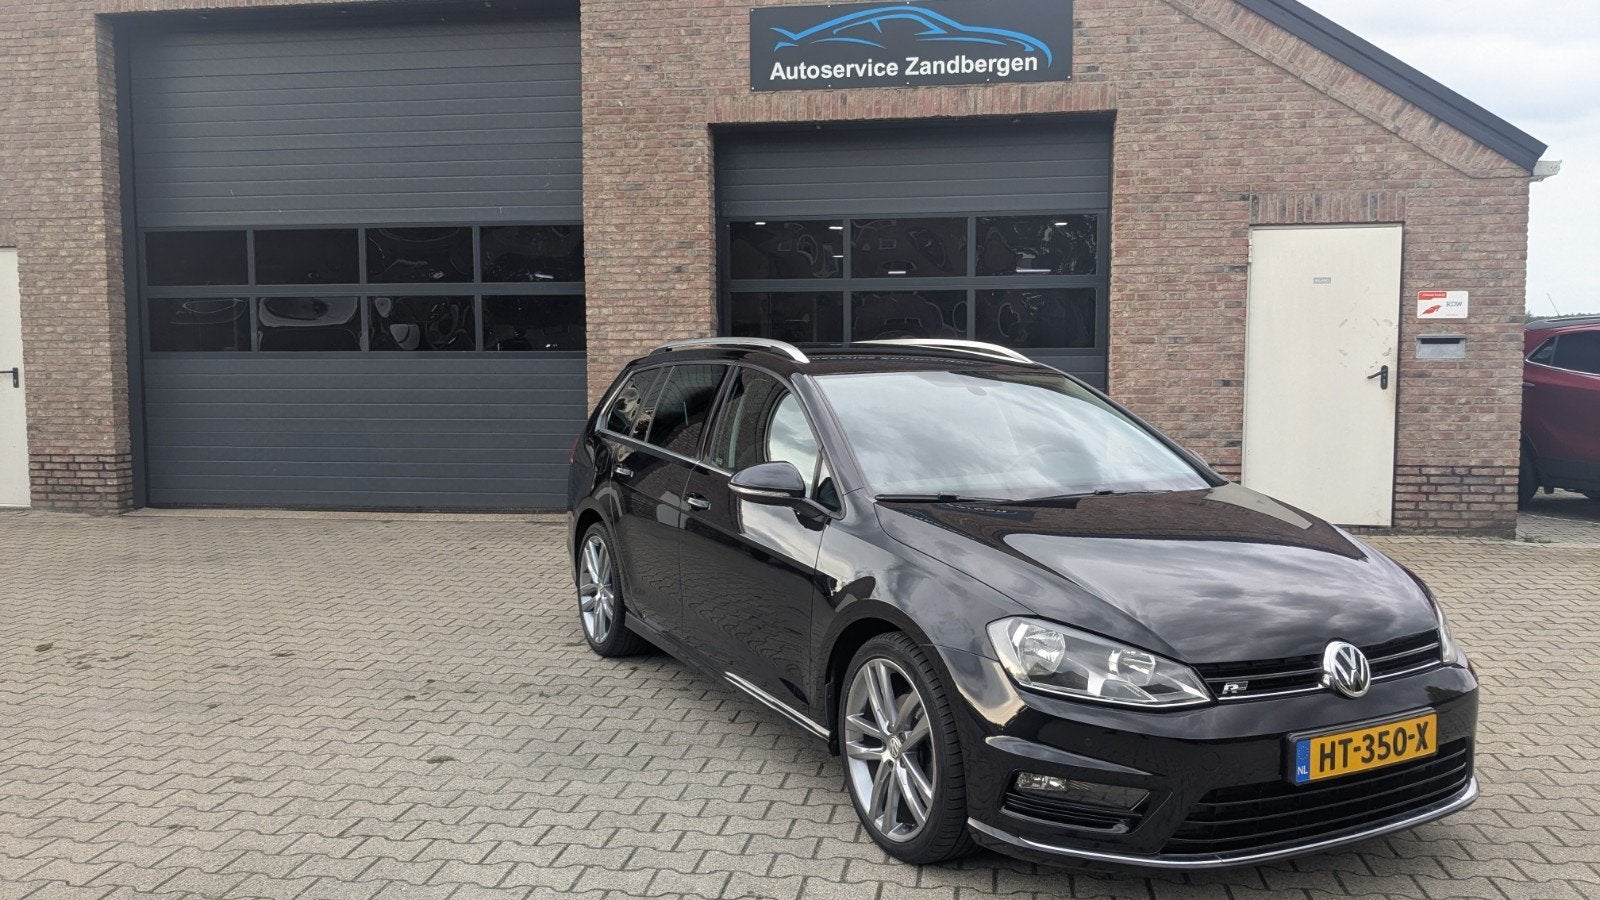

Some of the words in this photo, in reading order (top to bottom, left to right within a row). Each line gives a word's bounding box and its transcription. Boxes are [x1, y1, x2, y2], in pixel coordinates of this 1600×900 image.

[769, 58, 899, 81] Autoservice
[904, 54, 1038, 77] Zandbergen
[1319, 721, 1429, 773] HT-350-X
[1297, 766, 1309, 776] NL
